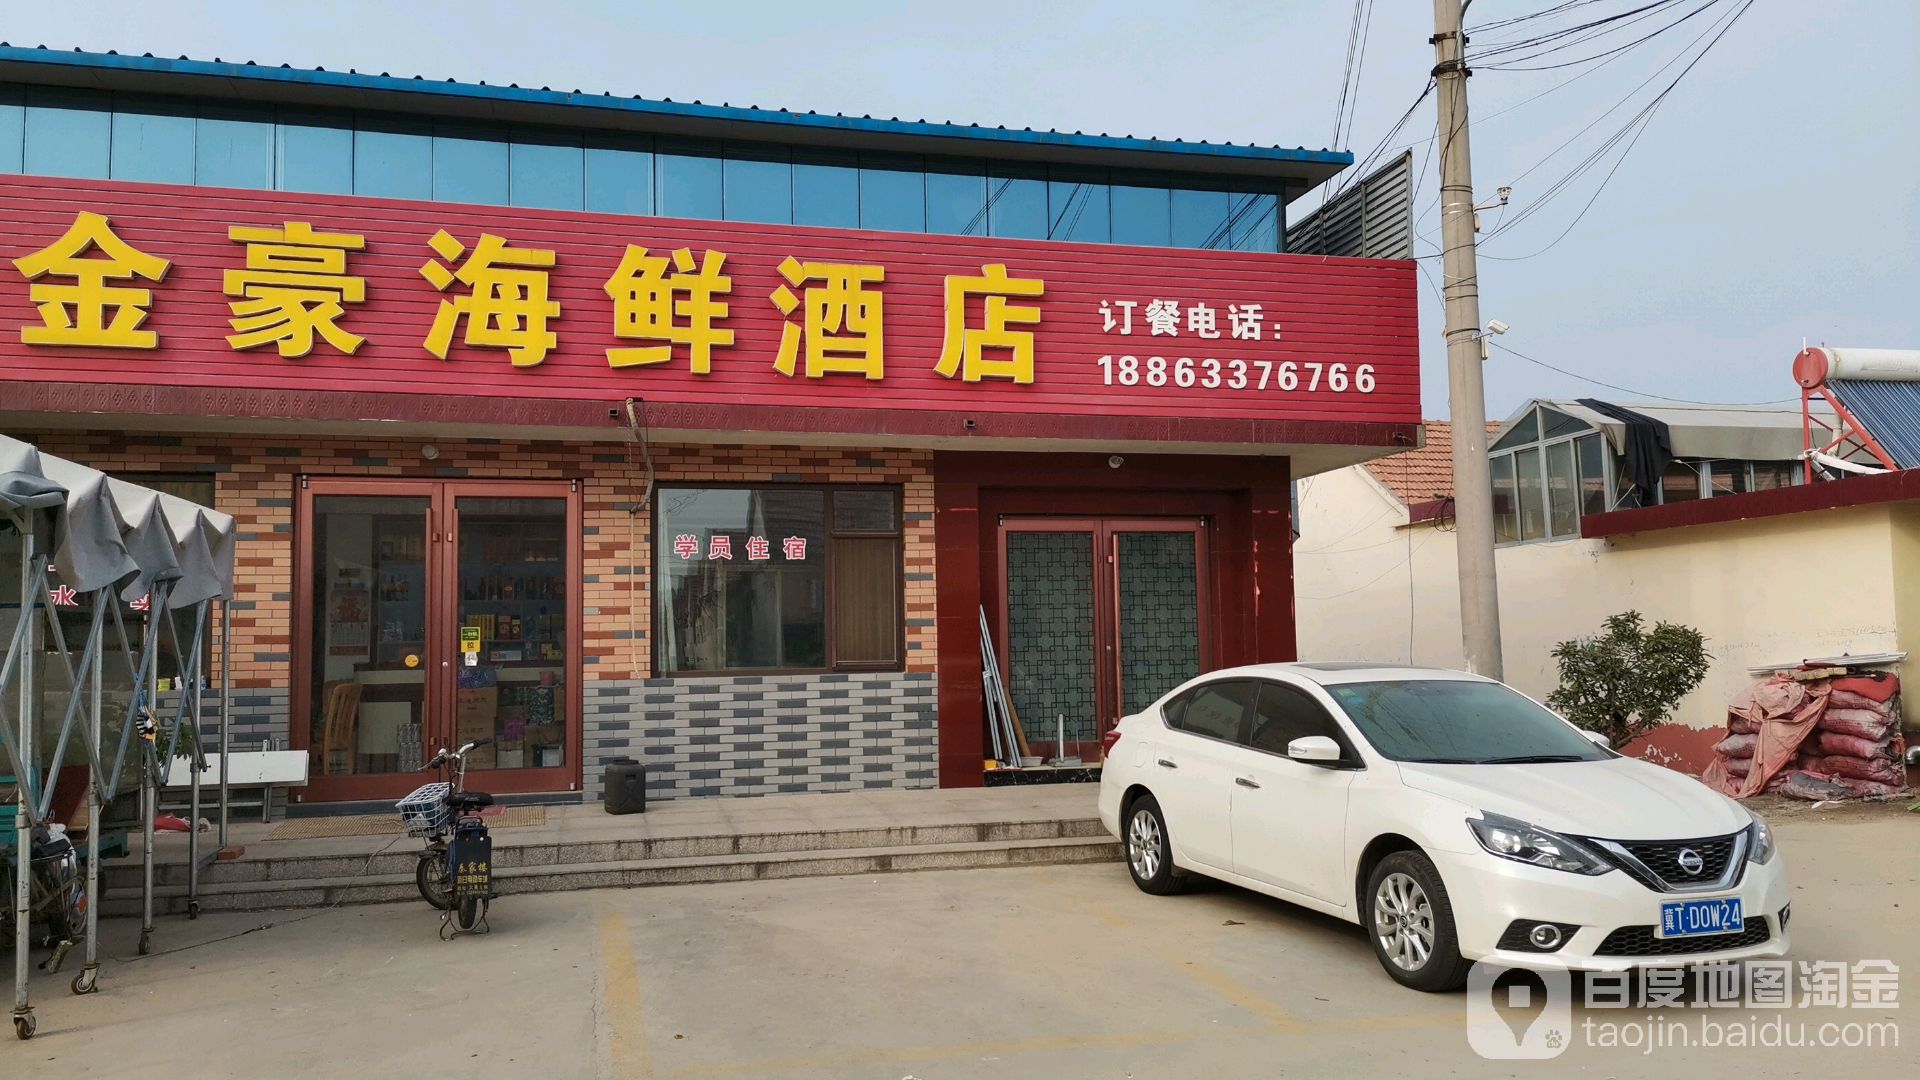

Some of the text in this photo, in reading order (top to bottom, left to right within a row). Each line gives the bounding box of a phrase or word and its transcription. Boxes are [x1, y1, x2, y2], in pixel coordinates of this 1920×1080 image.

[12, 210, 1045, 385] 金豪海鲜酒店
[1097, 355, 1377, 393] 18863376766
[673, 534, 807, 561] 学员住宿
